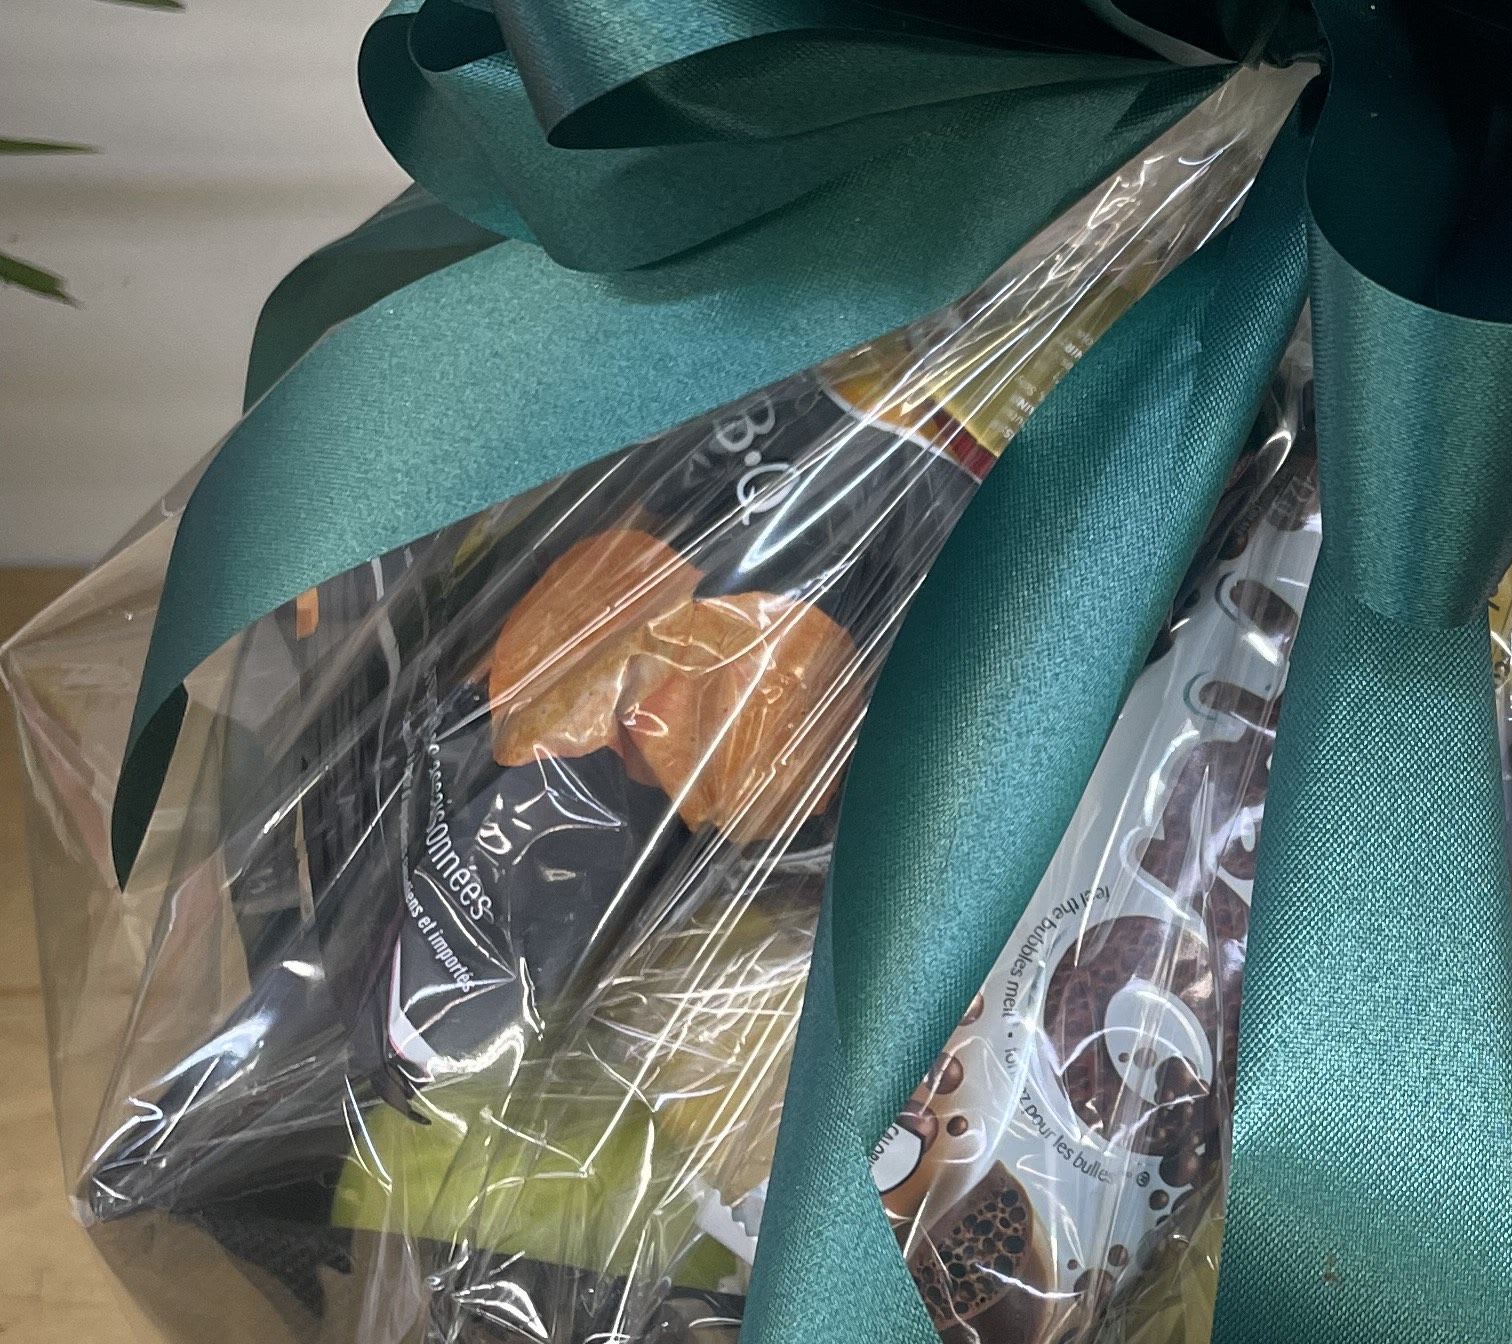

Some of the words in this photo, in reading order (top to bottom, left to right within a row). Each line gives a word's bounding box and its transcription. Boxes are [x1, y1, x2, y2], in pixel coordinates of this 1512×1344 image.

[1053, 894, 1083, 921] the
[418, 915, 437, 935] et
[428, 928, 474, 993] importés
[1010, 914, 1058, 979] bubbles
[1023, 1102, 1056, 1142] pour
[1053, 1134, 1074, 1162] les
